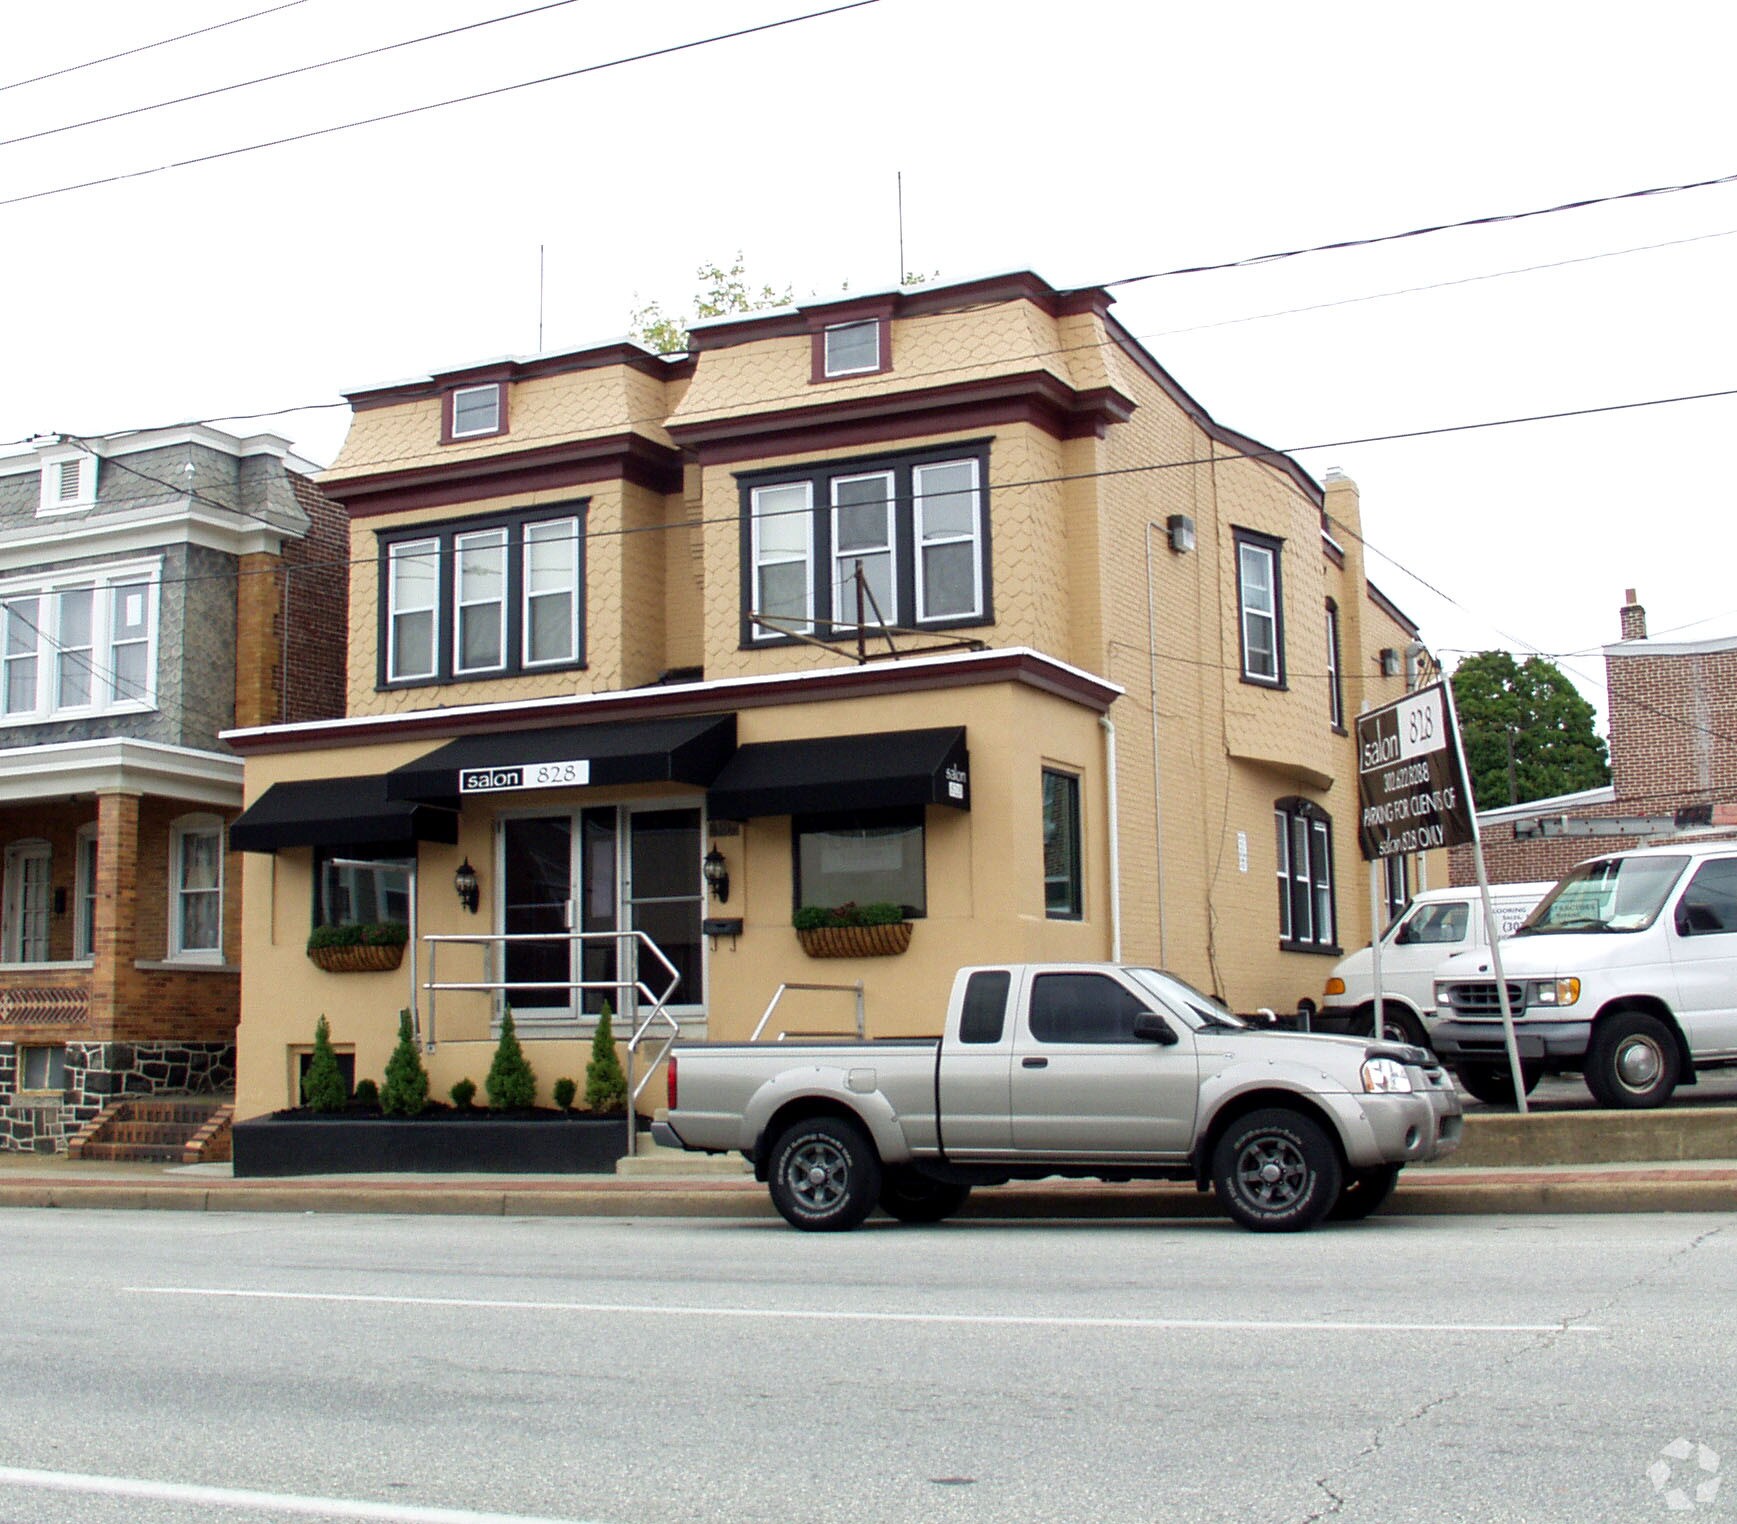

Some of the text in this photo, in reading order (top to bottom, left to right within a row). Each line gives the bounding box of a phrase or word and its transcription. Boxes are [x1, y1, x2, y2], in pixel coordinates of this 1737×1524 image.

[1364, 706, 1434, 767] salon 828
[467, 765, 576, 789] salon 828
[1363, 787, 1456, 828] PARKING FOR CLIENTS OF
[1418, 824, 1444, 847] ONLY
